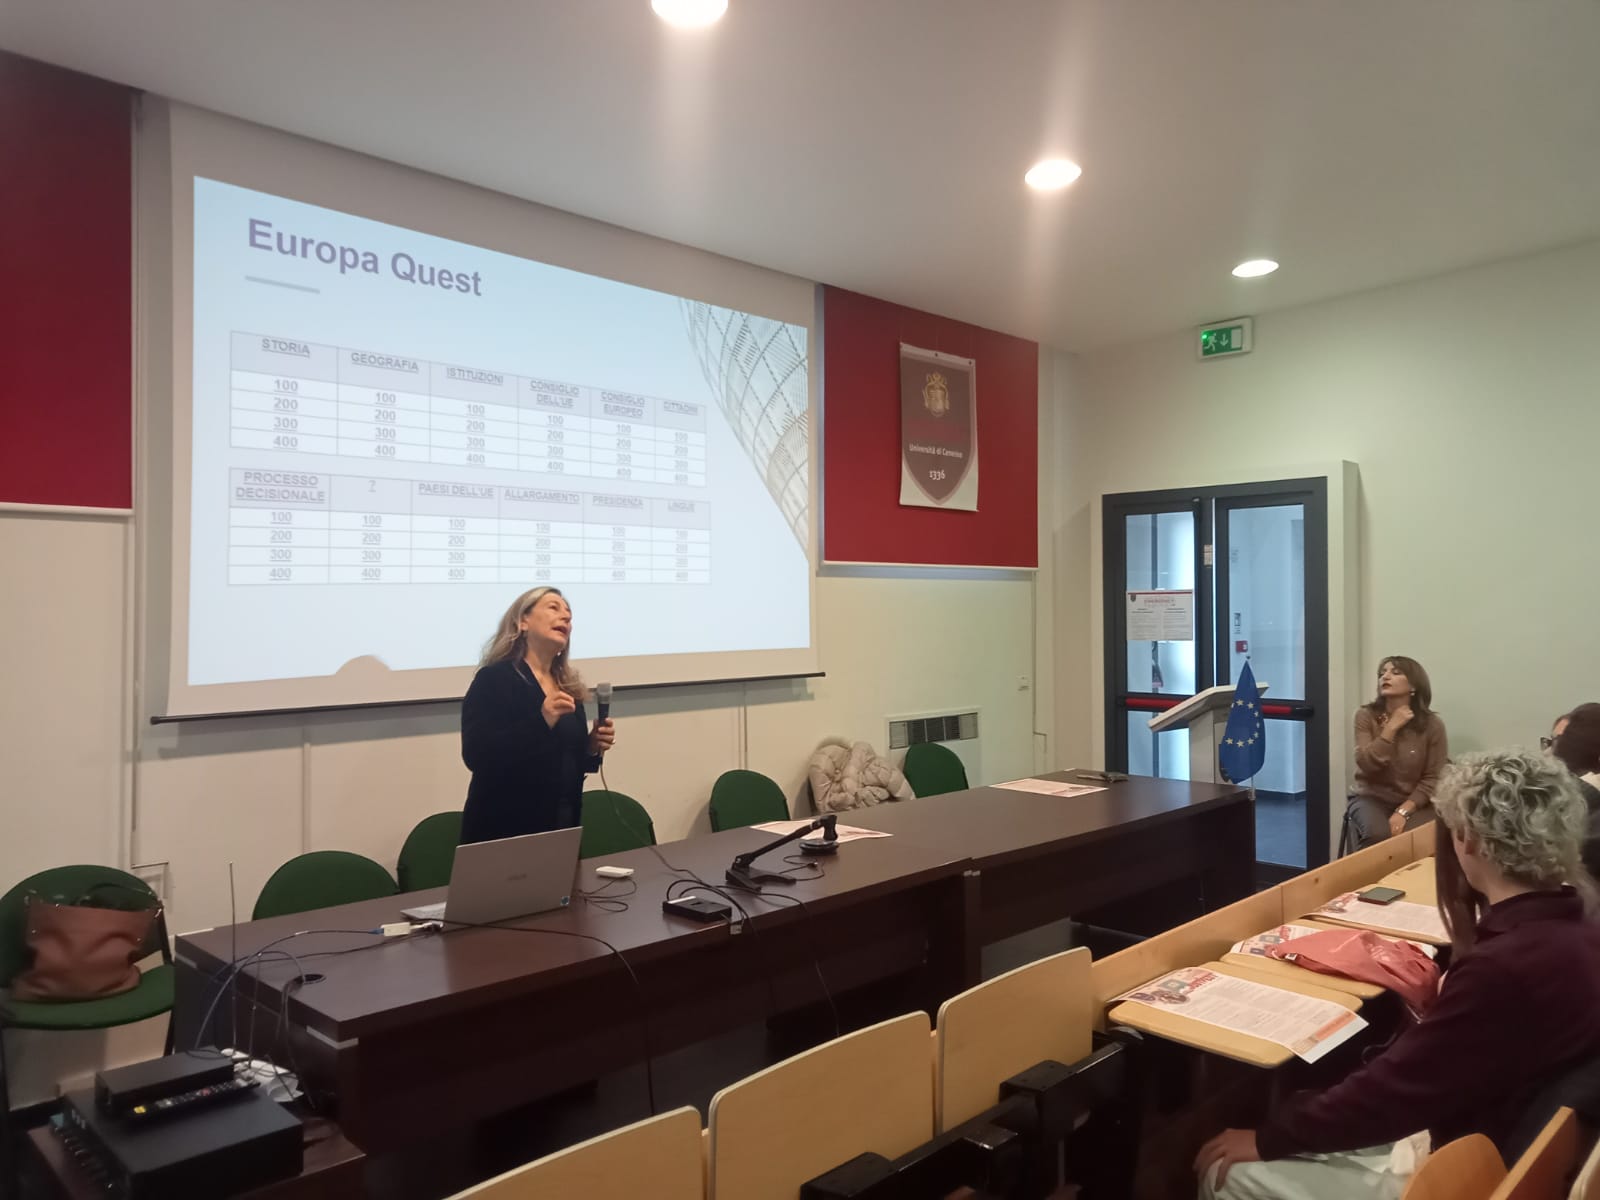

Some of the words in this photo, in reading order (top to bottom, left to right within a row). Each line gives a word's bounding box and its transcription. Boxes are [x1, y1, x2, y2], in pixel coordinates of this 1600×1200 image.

[248, 217, 380, 274] Europa
[390, 252, 483, 297] Quest
[261, 337, 311, 355] STORIA
[351, 352, 419, 371] GEOGRAFIA
[446, 367, 504, 385] ISTITUZIONI
[273, 379, 298, 391] 100
[530, 380, 580, 396] CONSIGLIO
[273, 397, 298, 410] 200
[374, 392, 396, 404] 100
[374, 409, 396, 421] 200
[466, 403, 485, 415] 100
[273, 417, 298, 429] 300
[466, 420, 485, 432] 200
[547, 415, 564, 426] 100
[374, 427, 396, 439] 300
[616, 424, 632, 434] 100
[273, 435, 298, 448] 400
[547, 430, 564, 441] 200
[466, 437, 485, 449] 300
[374, 445, 396, 457] 400
[466, 453, 485, 465] 400
[547, 461, 564, 472] 400
[243, 471, 319, 486] PROCESSO
[929, 469, 946, 481] 1336
[235, 487, 326, 502] DECISIONALE
[418, 483, 449, 496] PAESI
[451, 485, 494, 498] DELL'UE
[270, 511, 292, 523] 100
[362, 515, 382, 526] 100
[449, 519, 466, 529] 100
[270, 530, 292, 541] 200
[362, 533, 382, 544] 200
[449, 535, 466, 545] 200
[270, 549, 292, 560] 300
[362, 550, 382, 561] 300
[449, 552, 466, 562] 300
[270, 568, 292, 579] 400
[362, 568, 382, 578] 400
[449, 568, 466, 578] 400
